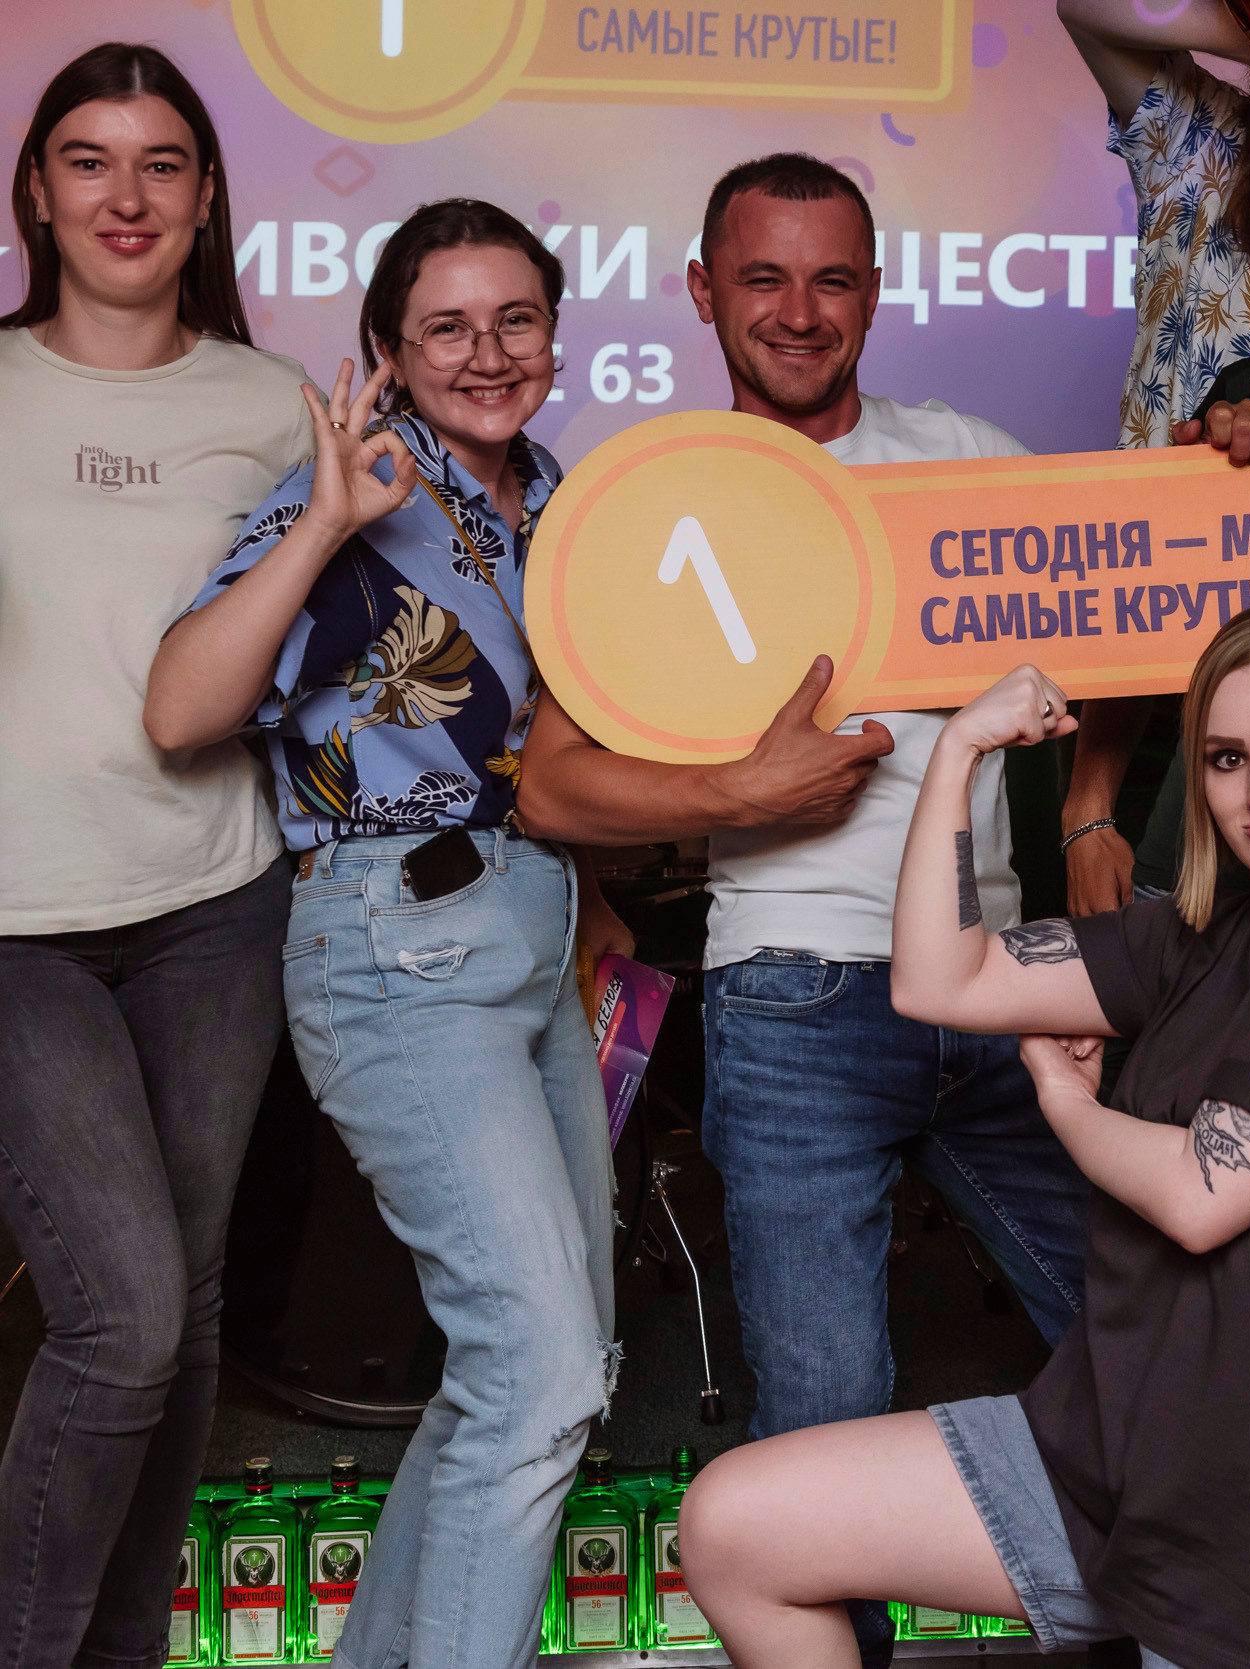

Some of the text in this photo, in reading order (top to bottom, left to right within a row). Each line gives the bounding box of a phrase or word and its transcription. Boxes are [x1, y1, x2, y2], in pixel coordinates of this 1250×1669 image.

[577, 7, 896, 65] САМЫЕ КРУТЫЕ!
[590, 342, 674, 404] 63
[80, 443, 104, 454] Into
[98, 452, 123, 465] the
[75, 452, 161, 492] light
[929, 520, 1152, 583] СЕГОДНЯ
[920, 589, 1102, 645] САМЫЕ
[592, 1600, 602, 1609] 56
[681, 1594, 691, 1604] 56
[248, 1610, 259, 1621] 56
[334, 1606, 345, 1616] 56
